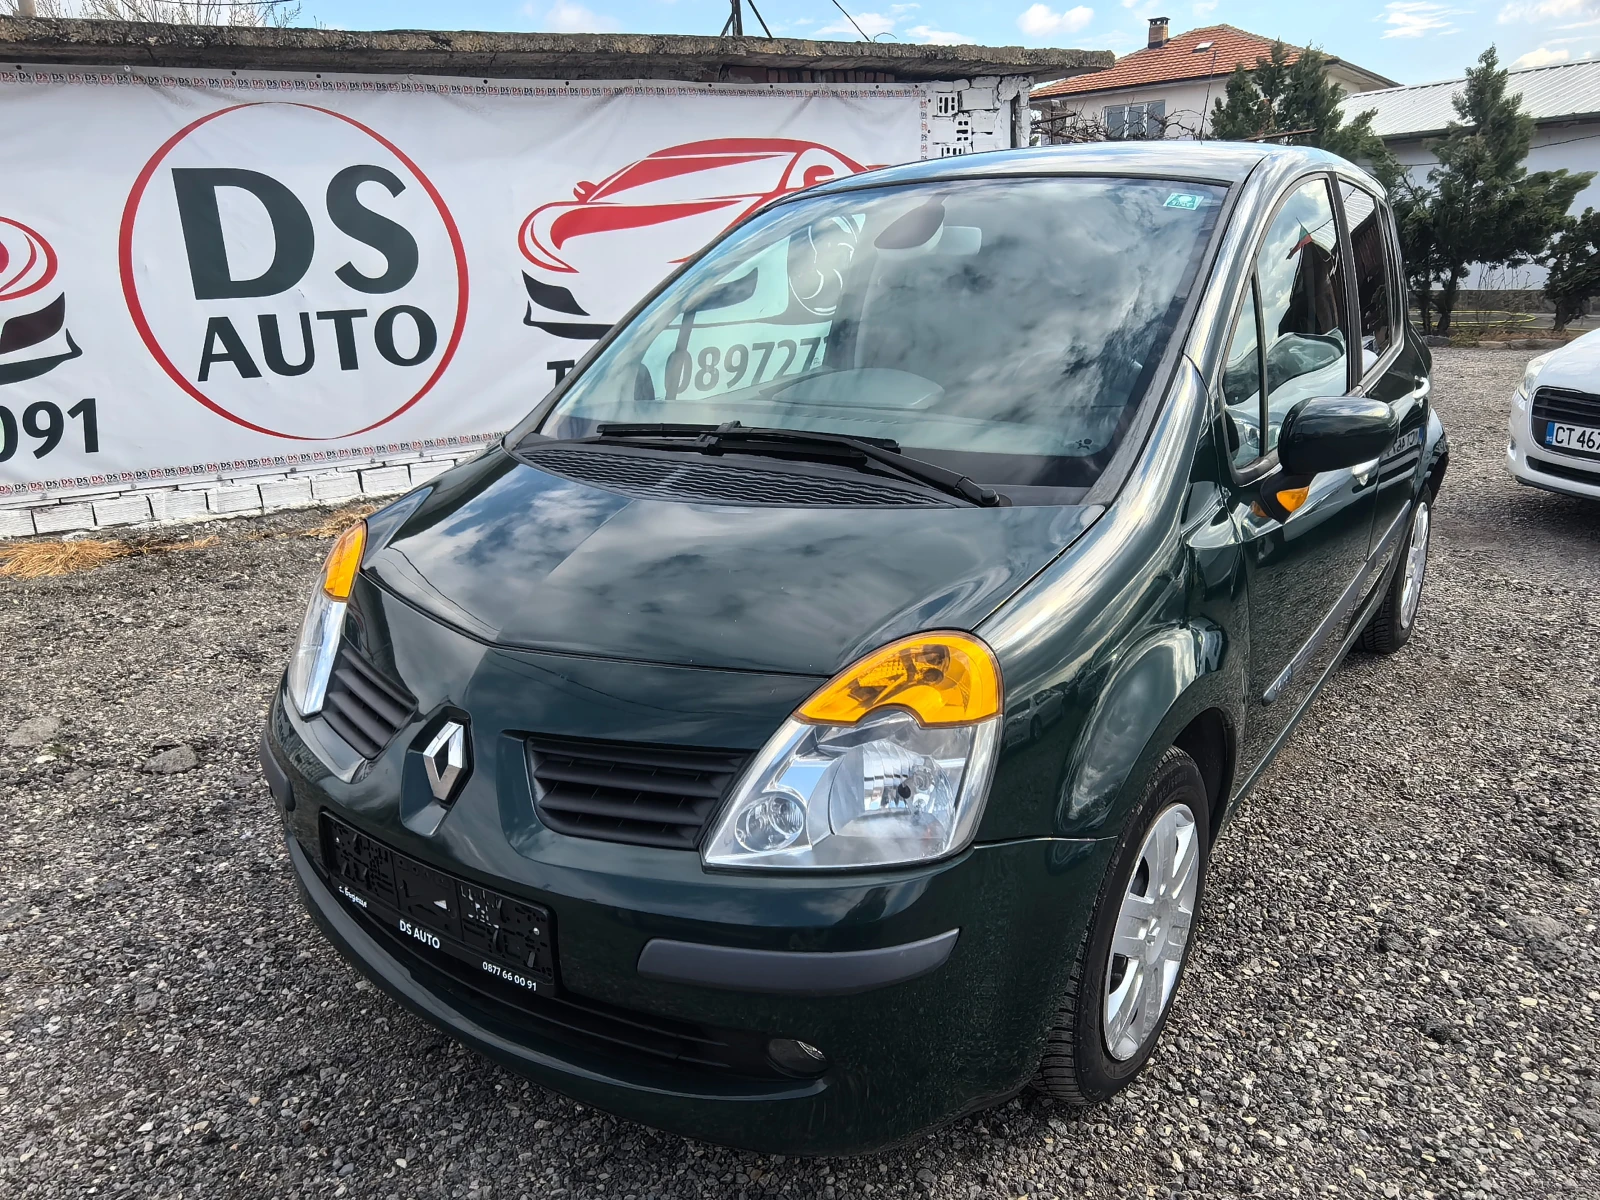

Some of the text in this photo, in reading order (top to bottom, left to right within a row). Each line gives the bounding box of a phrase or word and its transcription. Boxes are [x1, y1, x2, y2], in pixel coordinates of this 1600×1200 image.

[171, 164, 420, 300] DS
[197, 304, 438, 382] AUTO
[664, 336, 830, 395] 089727
[1555, 426, 1576, 446] CT
[399, 919, 441, 950] DS AUTO
[482, 961, 537, 992] 0877 66 00 91
